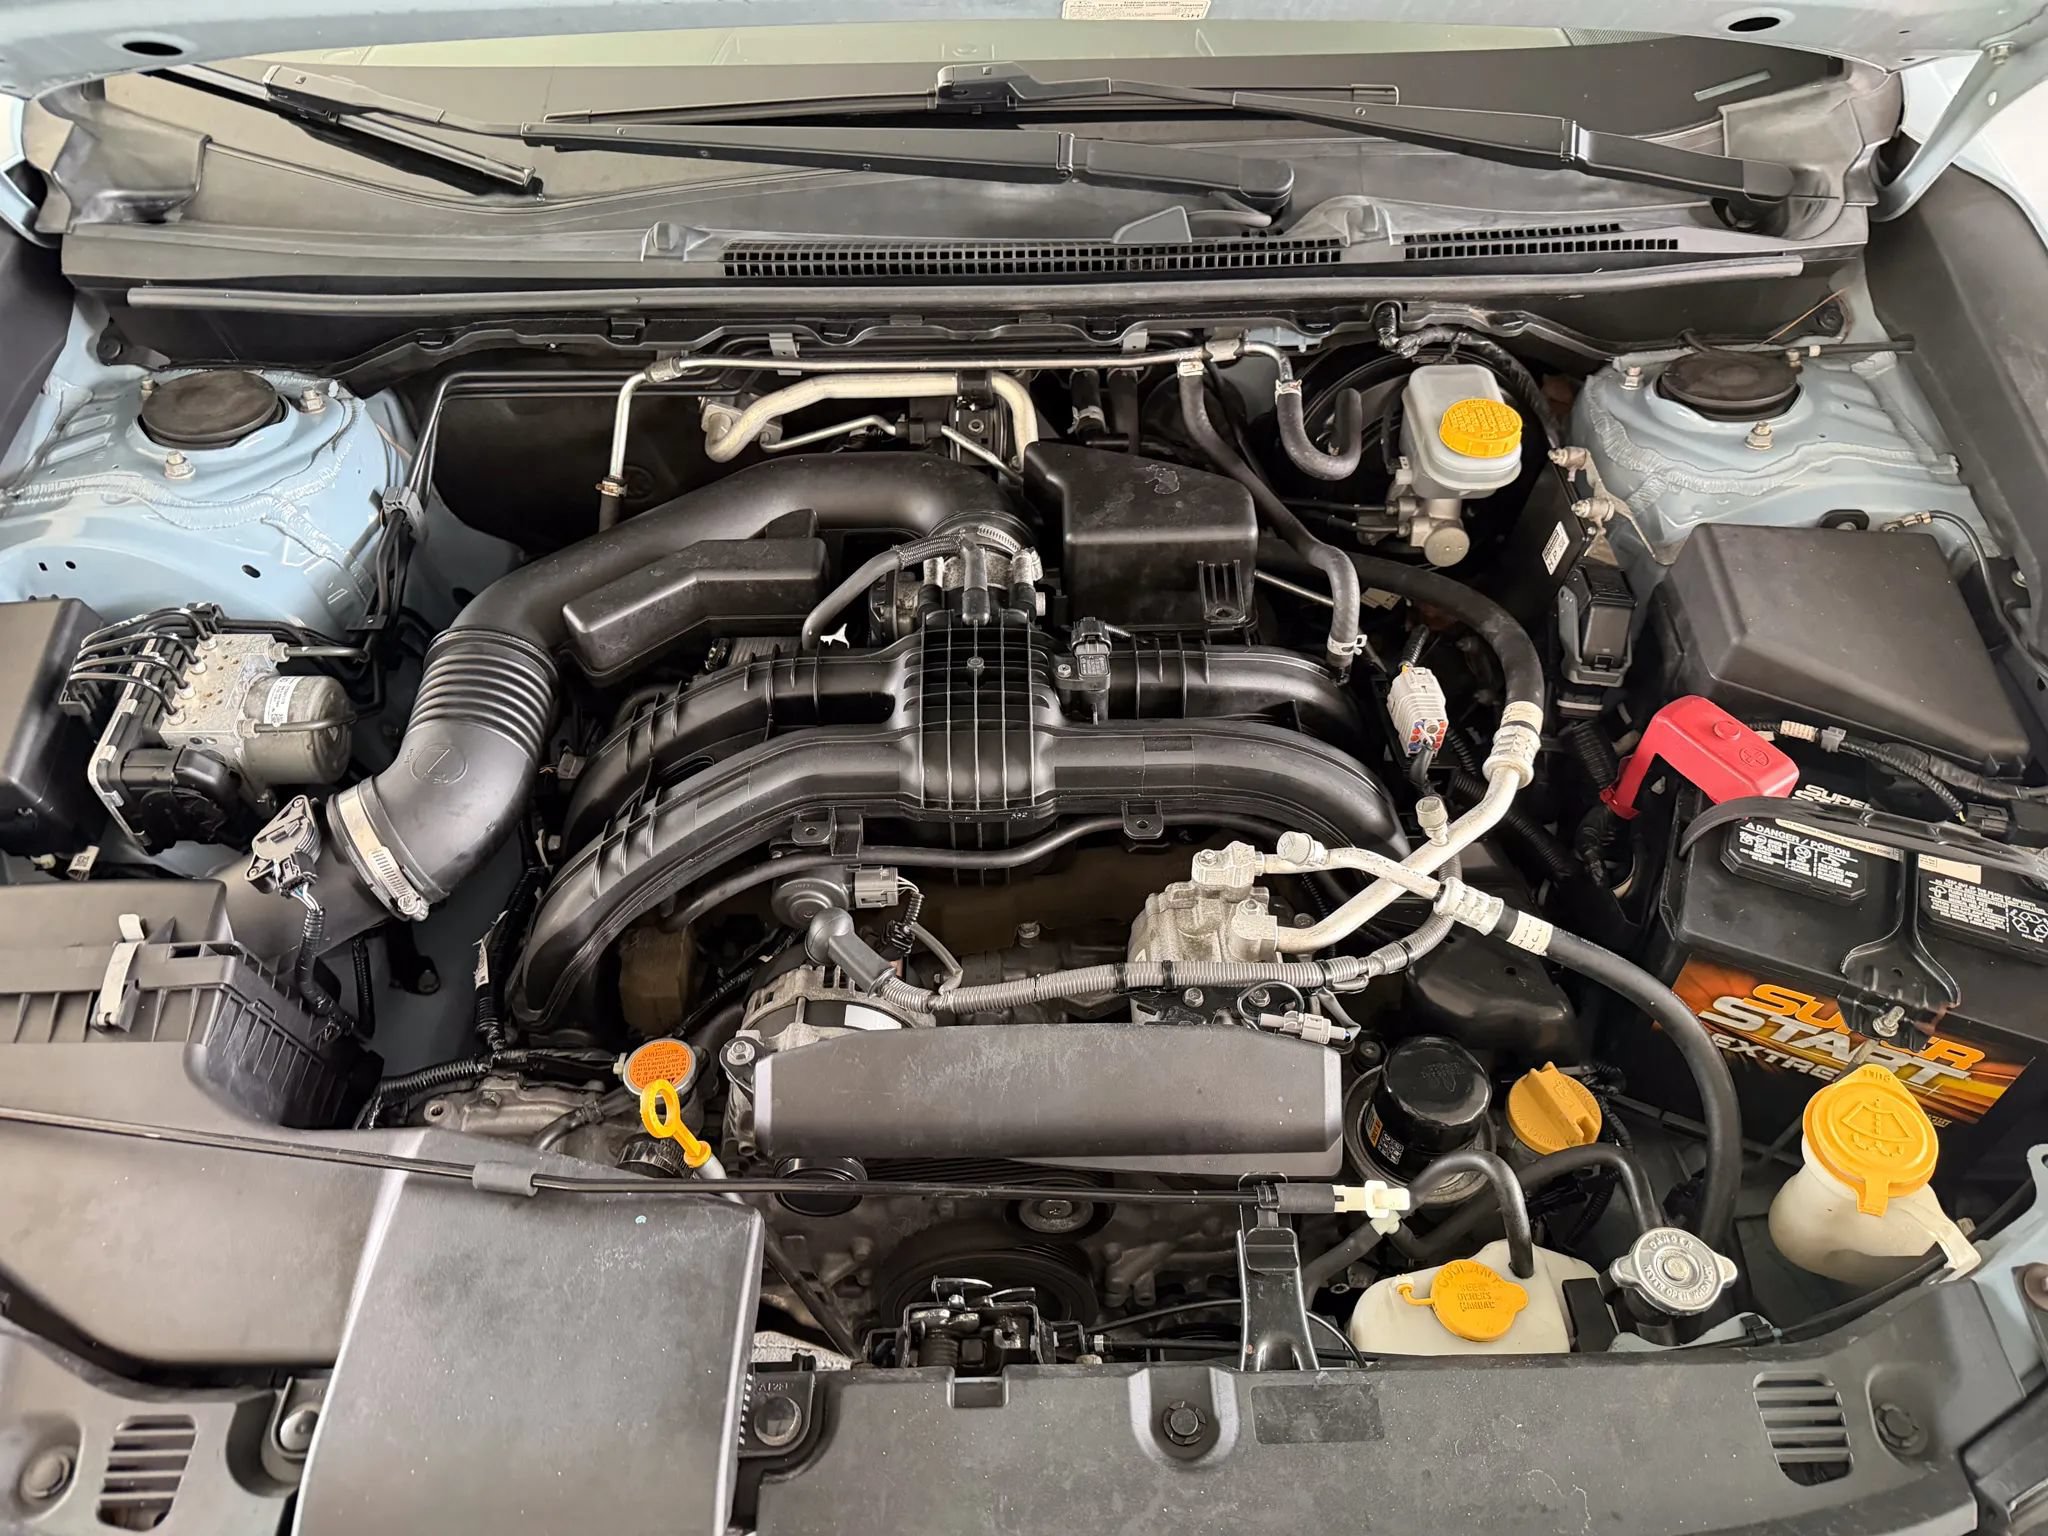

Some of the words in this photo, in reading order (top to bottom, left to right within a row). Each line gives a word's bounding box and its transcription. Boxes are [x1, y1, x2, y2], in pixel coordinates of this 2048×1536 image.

[1756, 825, 1800, 844] DANGER
[1810, 840, 1850, 858] POISON
[1698, 996, 1972, 1085] START
[1743, 984, 1986, 1071] SUR
[1711, 1033, 1842, 1084] EXTRE
[1648, 1232, 1693, 1250] DANGER
